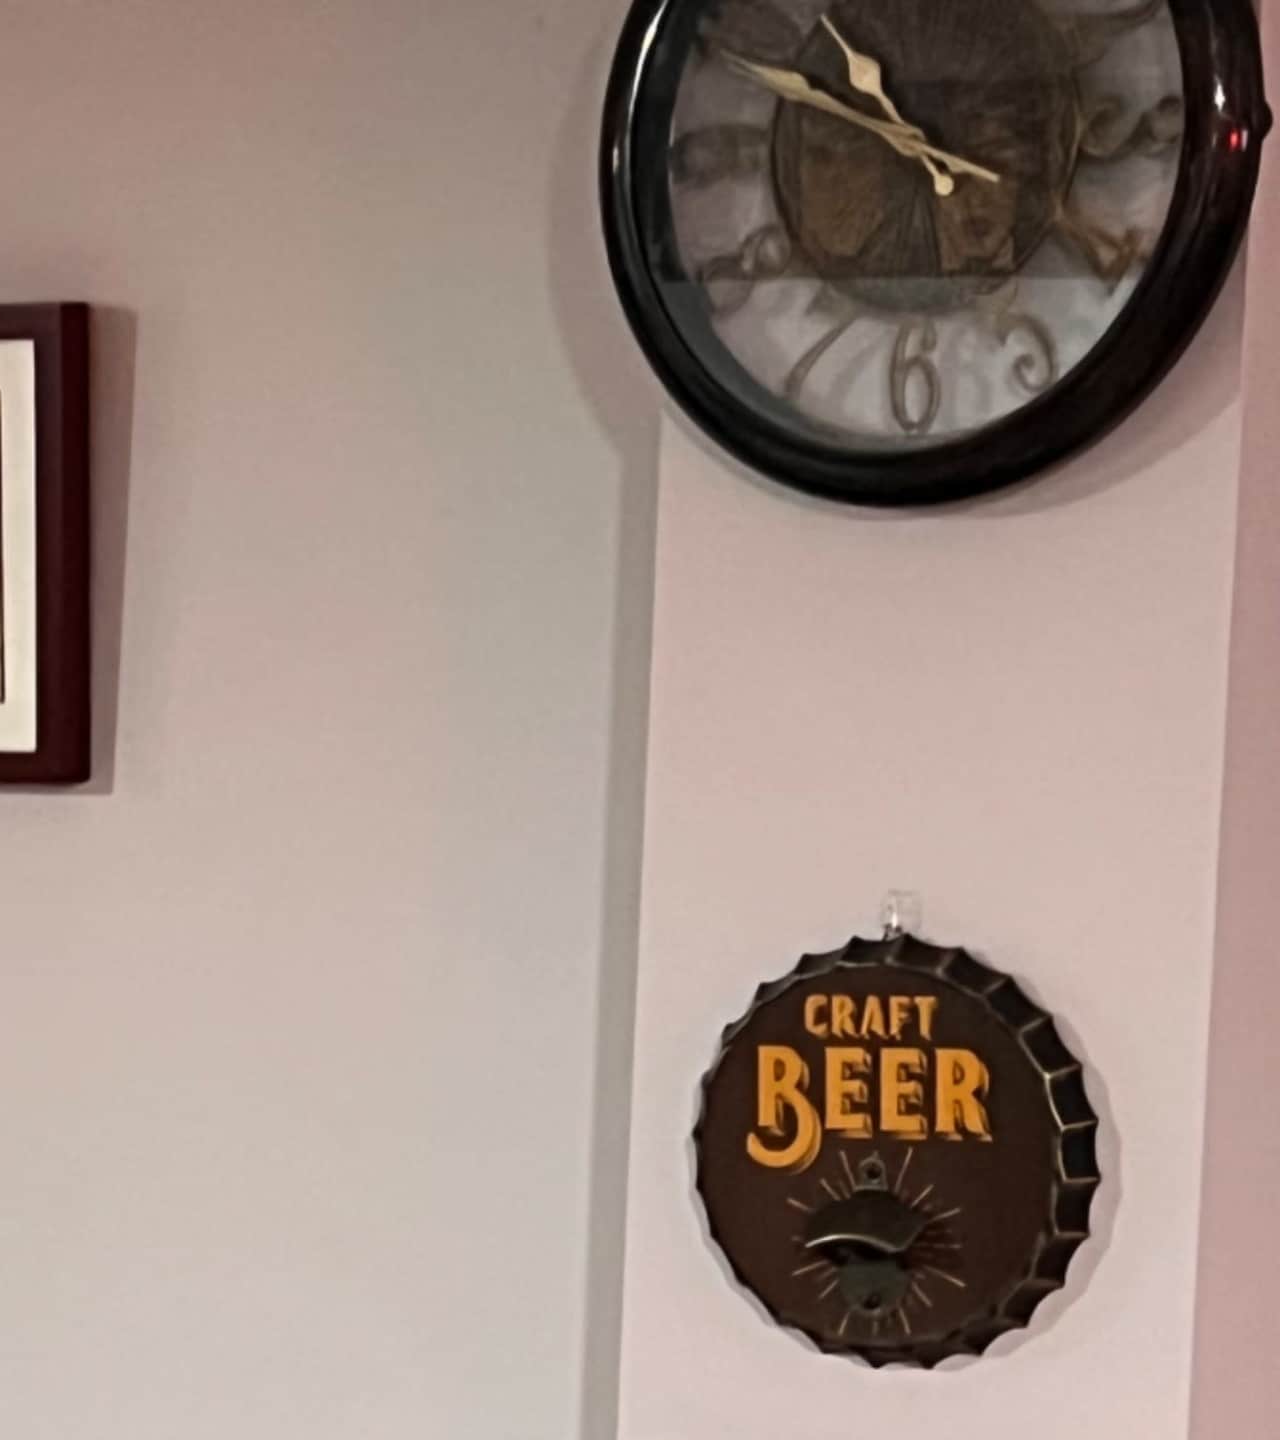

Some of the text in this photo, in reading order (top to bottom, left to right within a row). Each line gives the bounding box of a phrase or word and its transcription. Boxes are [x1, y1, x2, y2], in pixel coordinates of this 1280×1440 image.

[886, 320, 940, 438] 6
[803, 993, 940, 1042] CRAFT
[745, 1044, 995, 1176] BEER
